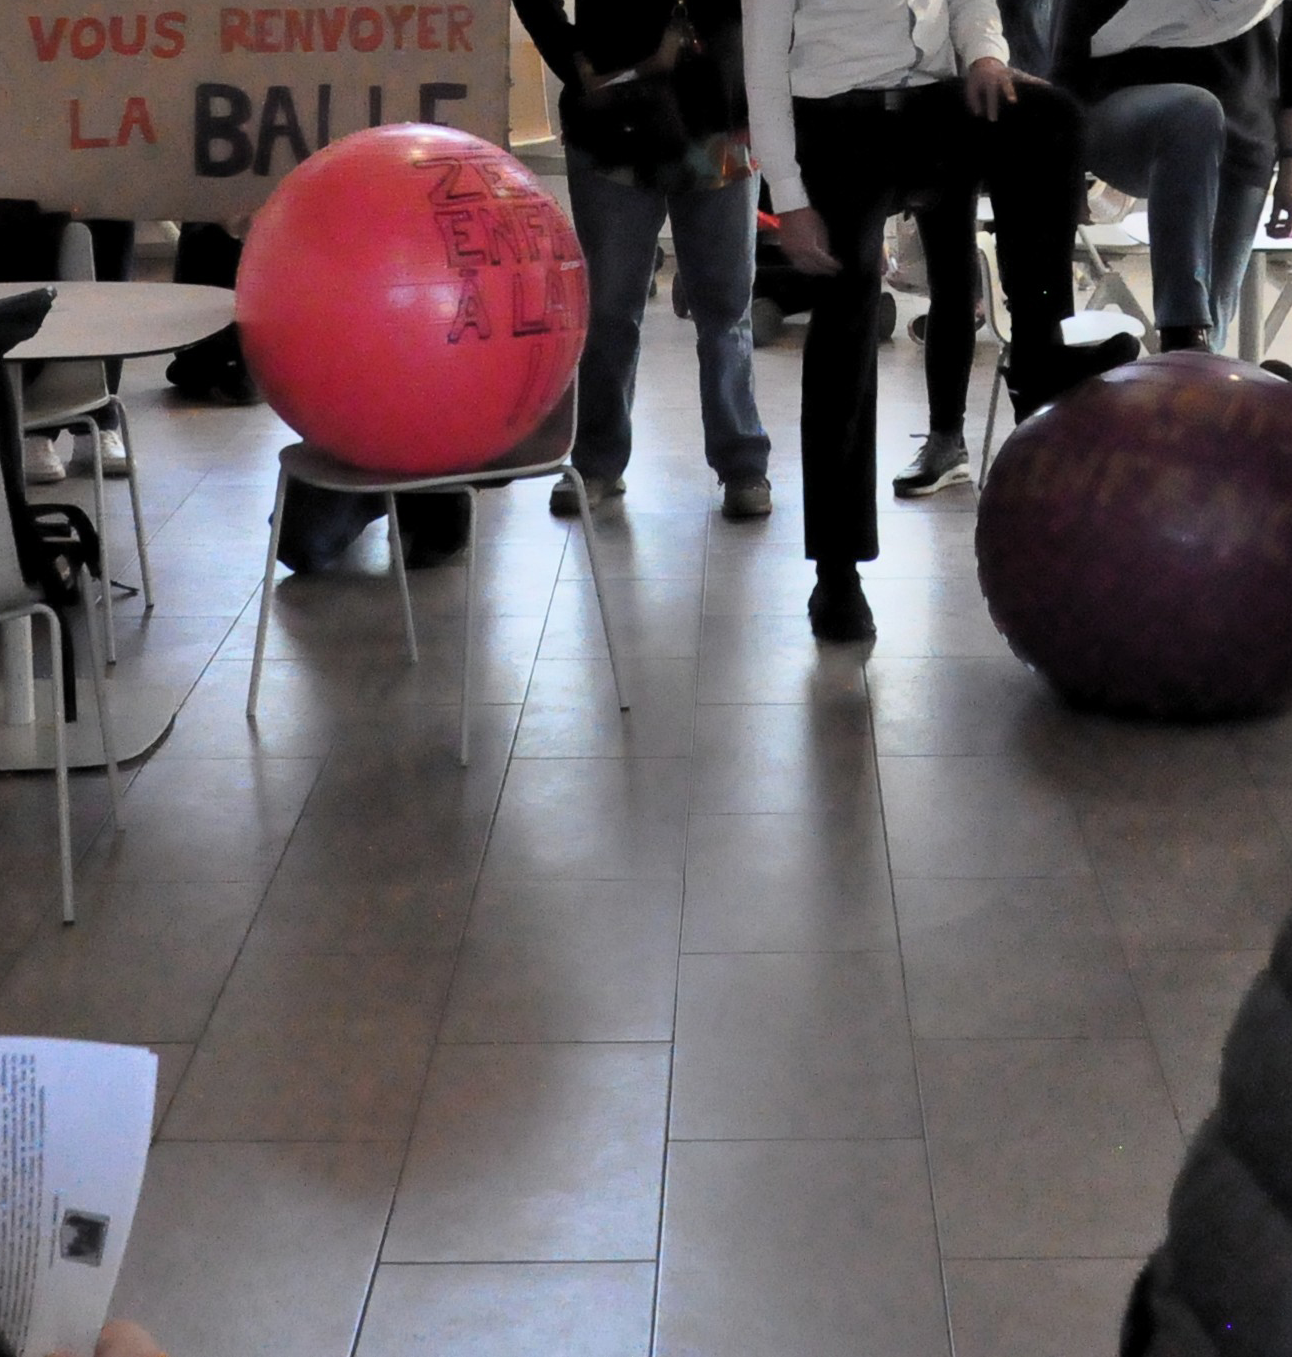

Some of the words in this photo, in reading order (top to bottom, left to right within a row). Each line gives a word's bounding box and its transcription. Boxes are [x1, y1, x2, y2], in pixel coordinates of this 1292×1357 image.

[28, 11, 187, 62] VOUS
[220, 5, 474, 53] RENVOYER
[69, 97, 158, 149] LA
